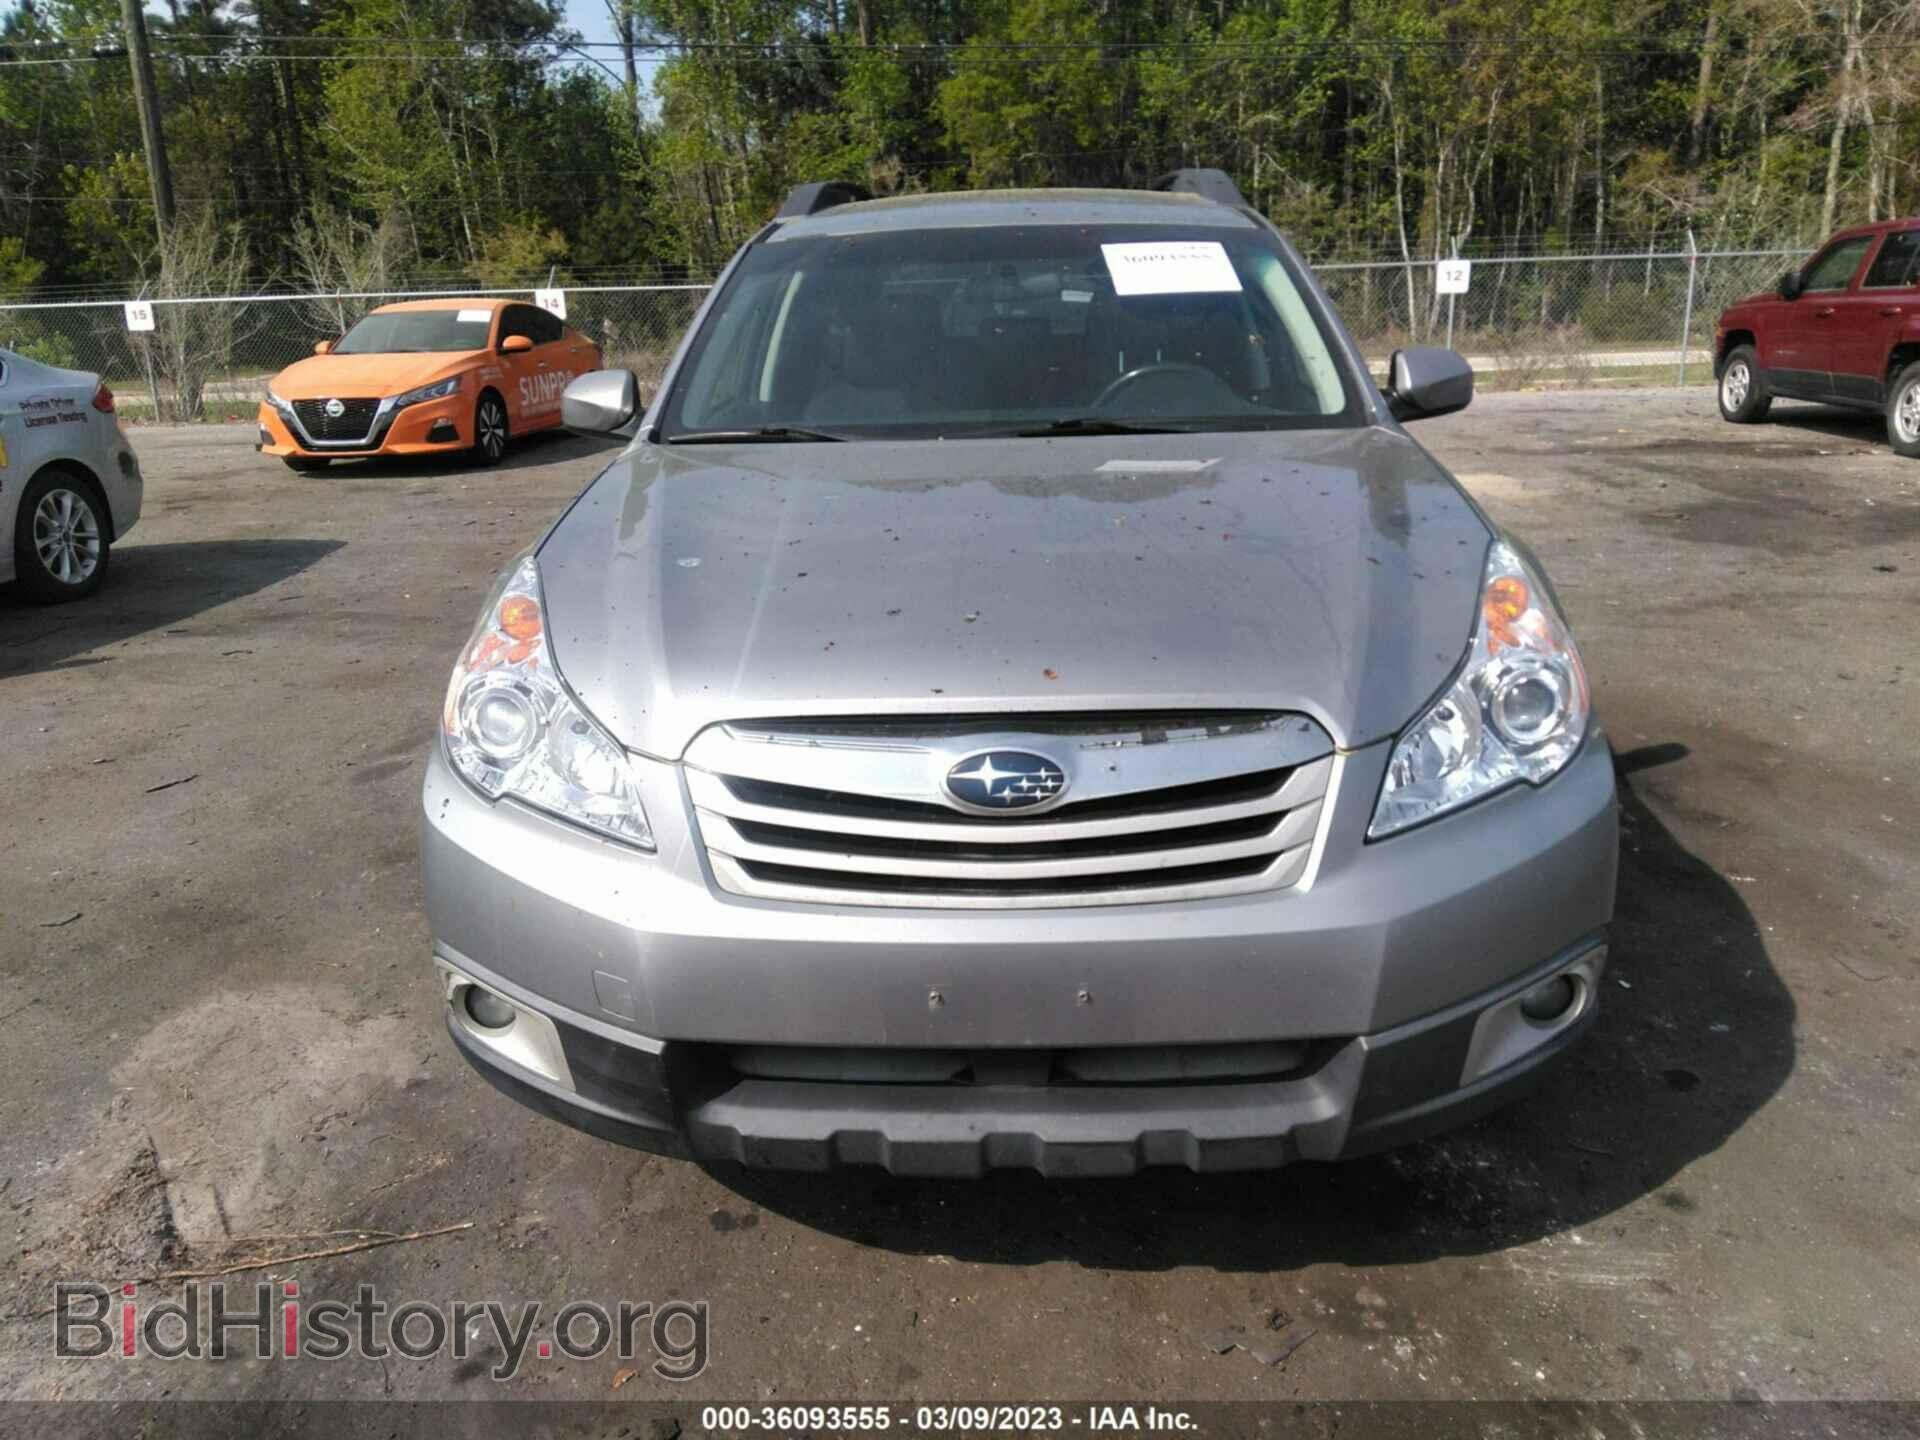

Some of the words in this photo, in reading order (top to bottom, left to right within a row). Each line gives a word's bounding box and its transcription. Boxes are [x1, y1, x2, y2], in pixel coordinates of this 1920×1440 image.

[1445, 270, 1464, 281] 12
[544, 298, 559, 309] 14
[131, 310, 148, 321] 15
